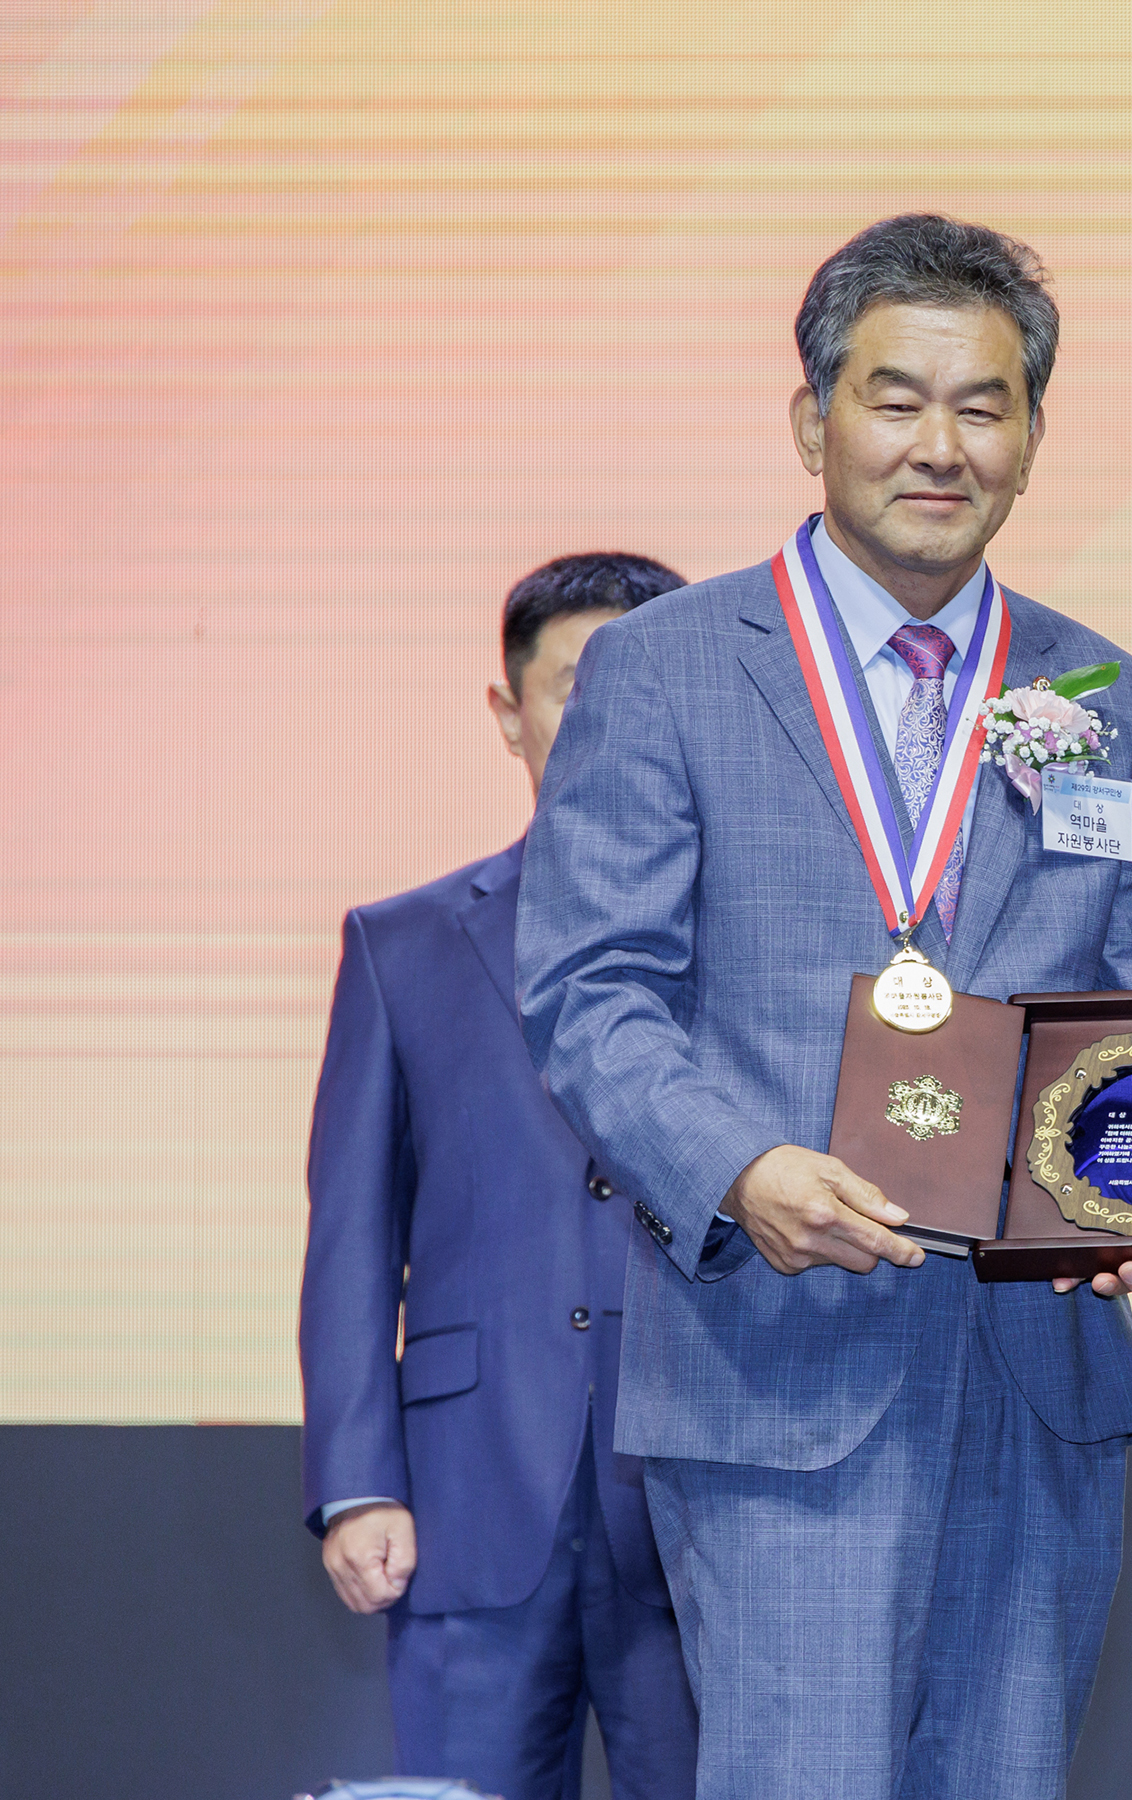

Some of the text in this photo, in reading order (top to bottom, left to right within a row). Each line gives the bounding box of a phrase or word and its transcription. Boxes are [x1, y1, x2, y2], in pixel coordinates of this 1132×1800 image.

[1071, 782, 1091, 793] 제29회
[1092, 785, 1122, 798] 강서구민상
[1073, 800, 1104, 814] 대 상
[1070, 814, 1107, 833] 역마을
[1057, 832, 1121, 855] 자원봉사단
[893, 976, 933, 988] 대 상
